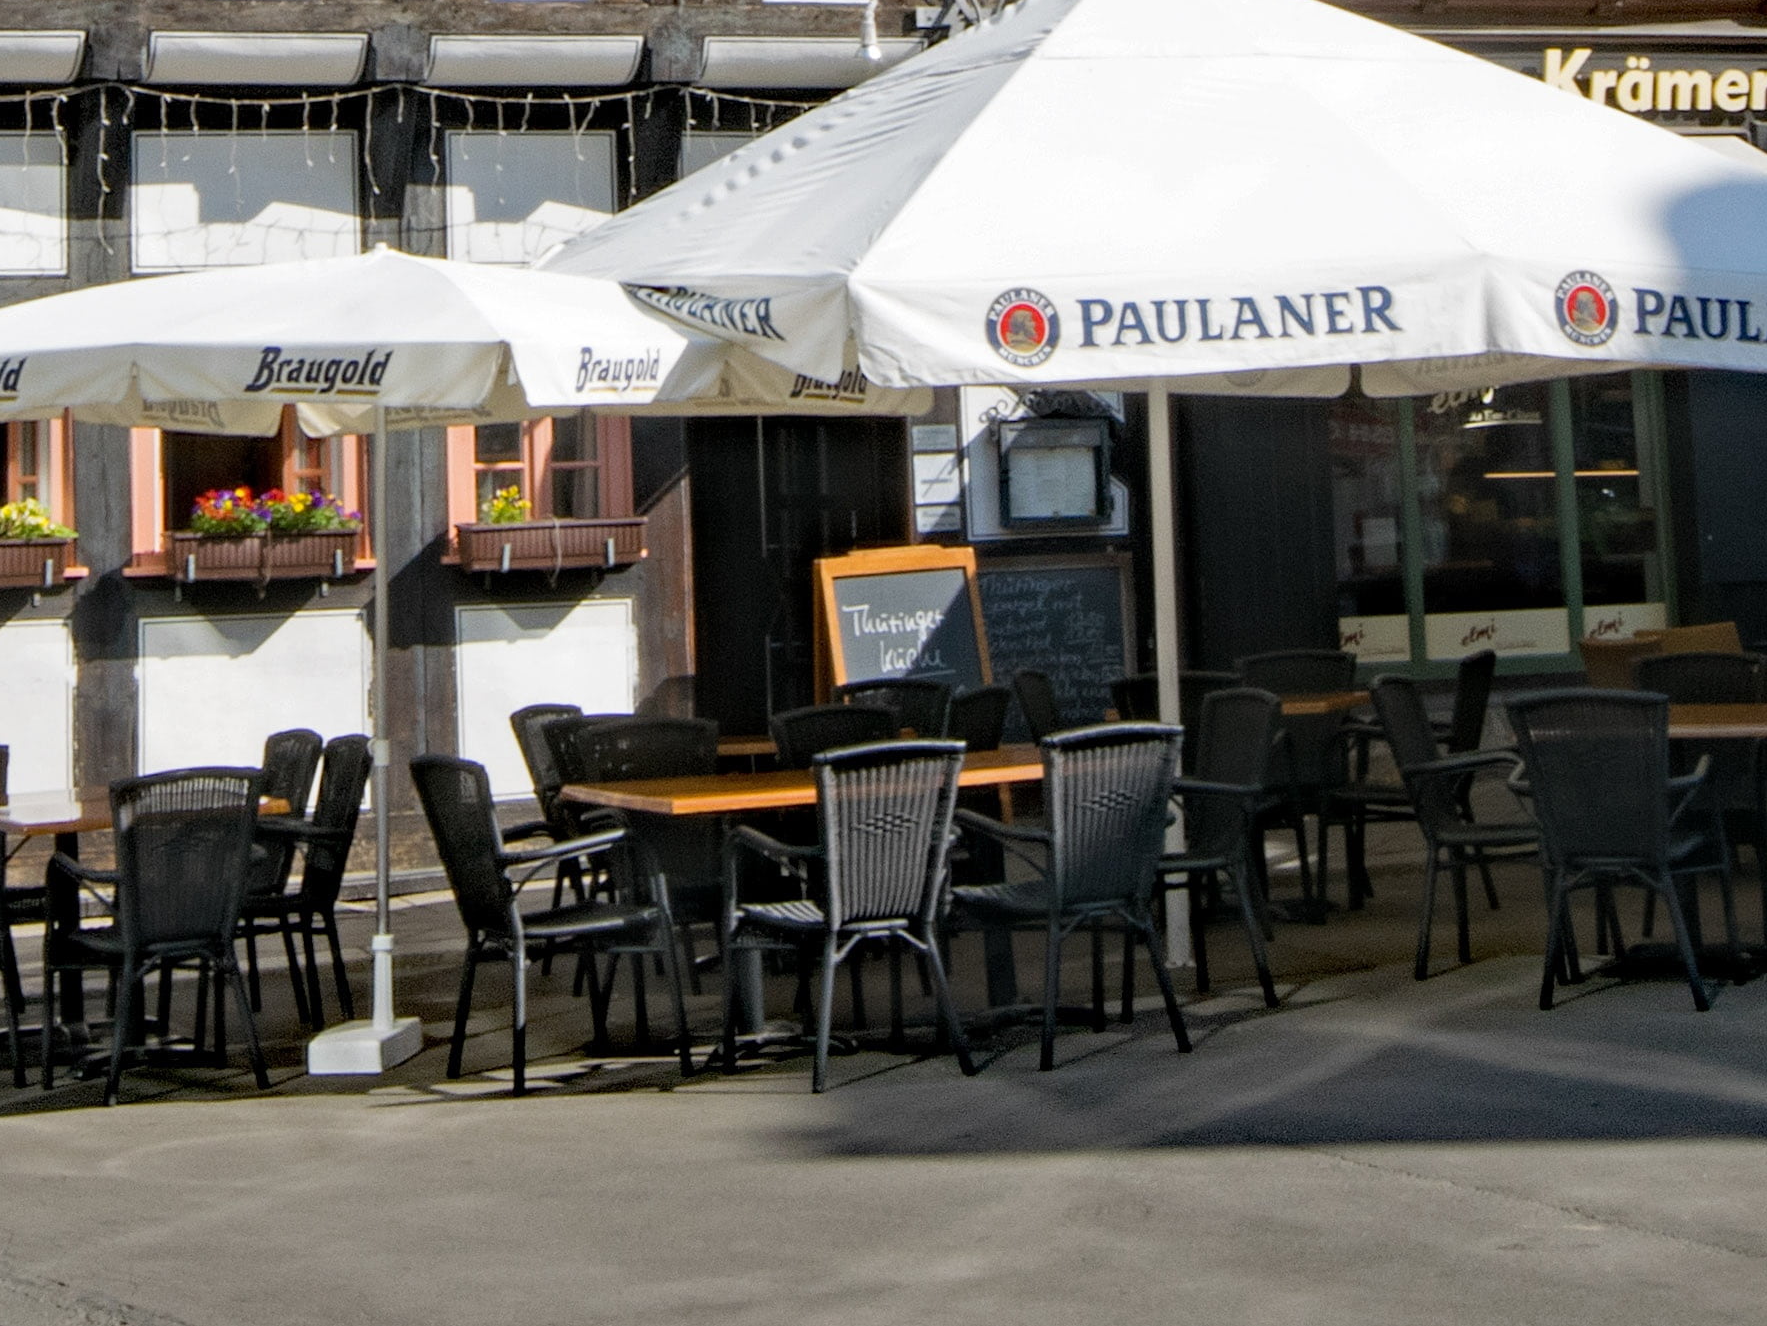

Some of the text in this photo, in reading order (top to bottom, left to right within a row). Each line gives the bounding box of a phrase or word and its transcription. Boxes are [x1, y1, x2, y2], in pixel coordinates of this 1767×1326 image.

[1075, 284, 1403, 348] PAULANER
[243, 346, 394, 393] Braugold
[575, 346, 659, 394] Braugold
[1460, 617, 1497, 647] elmi
